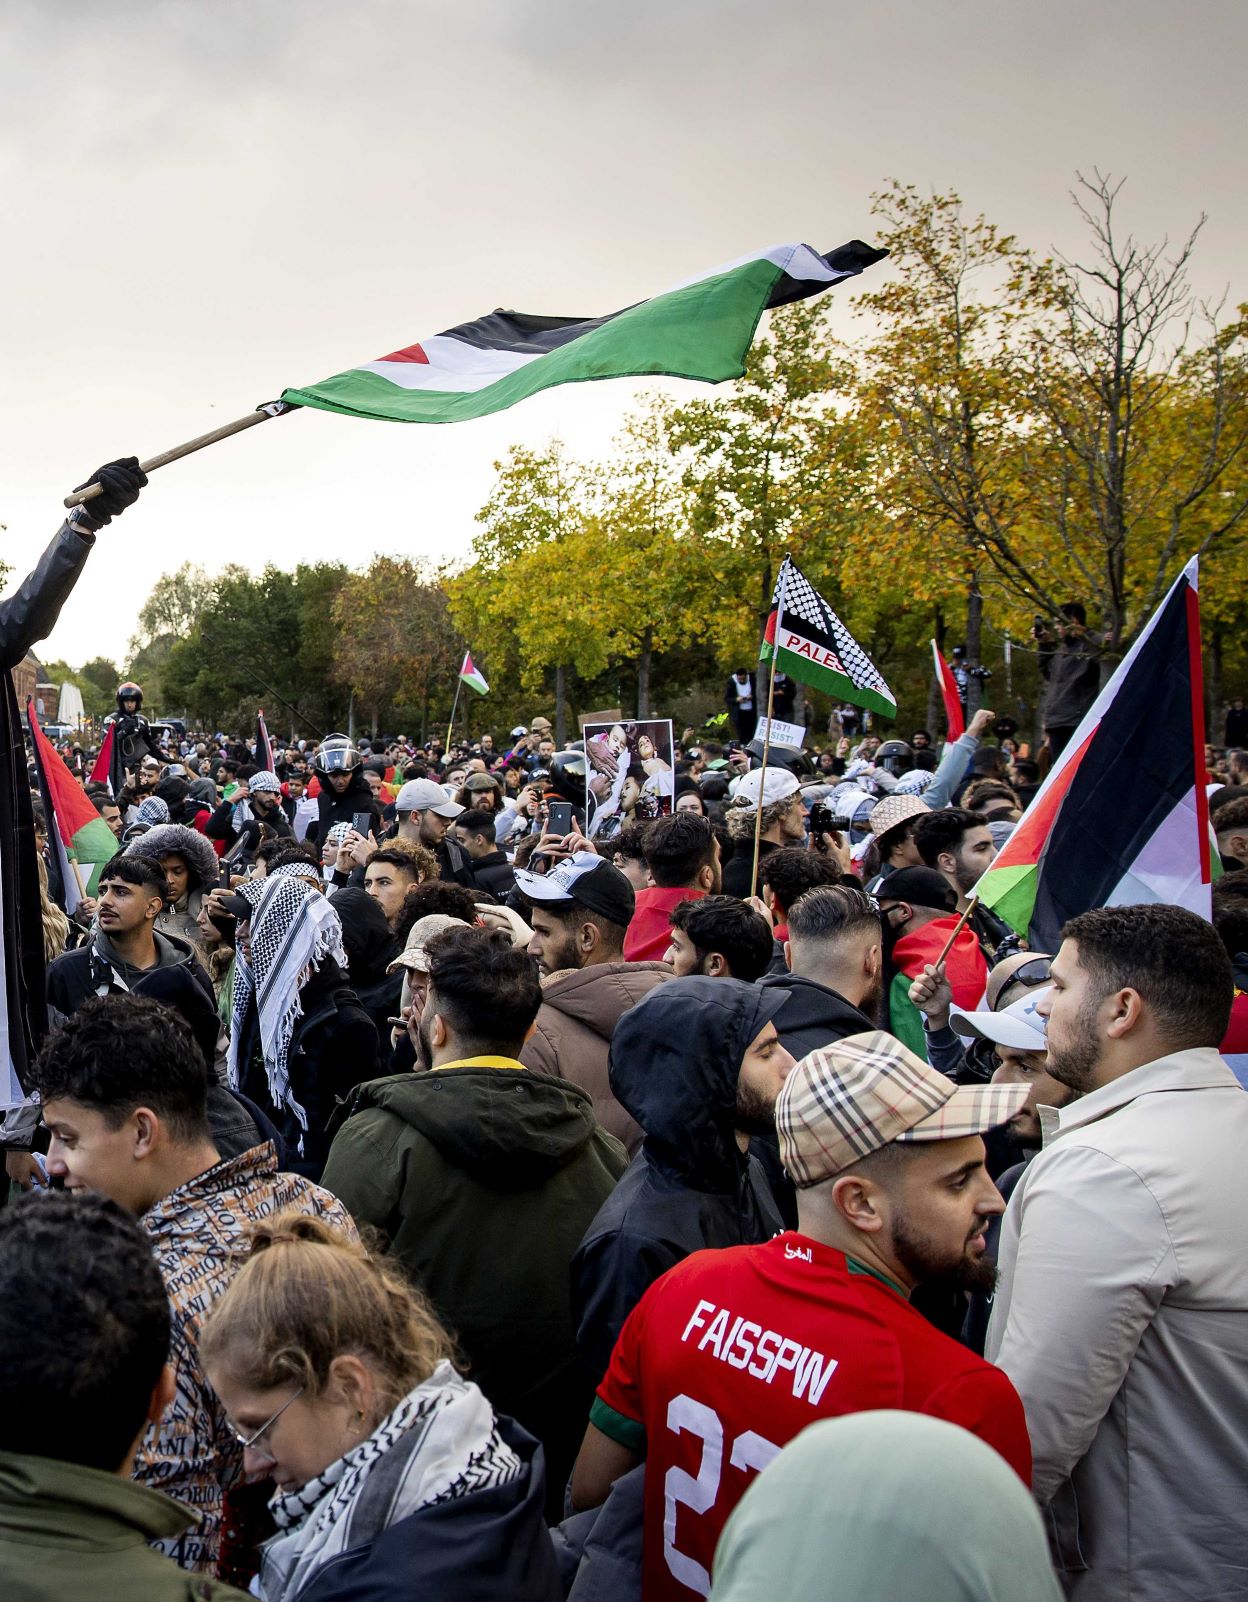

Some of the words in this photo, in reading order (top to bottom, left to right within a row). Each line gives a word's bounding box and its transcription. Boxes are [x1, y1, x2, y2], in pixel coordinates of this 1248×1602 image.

[762, 719, 791, 733] EIST!
[758, 729, 794, 743] RSIST!
[664, 1393, 784, 1600] 2
